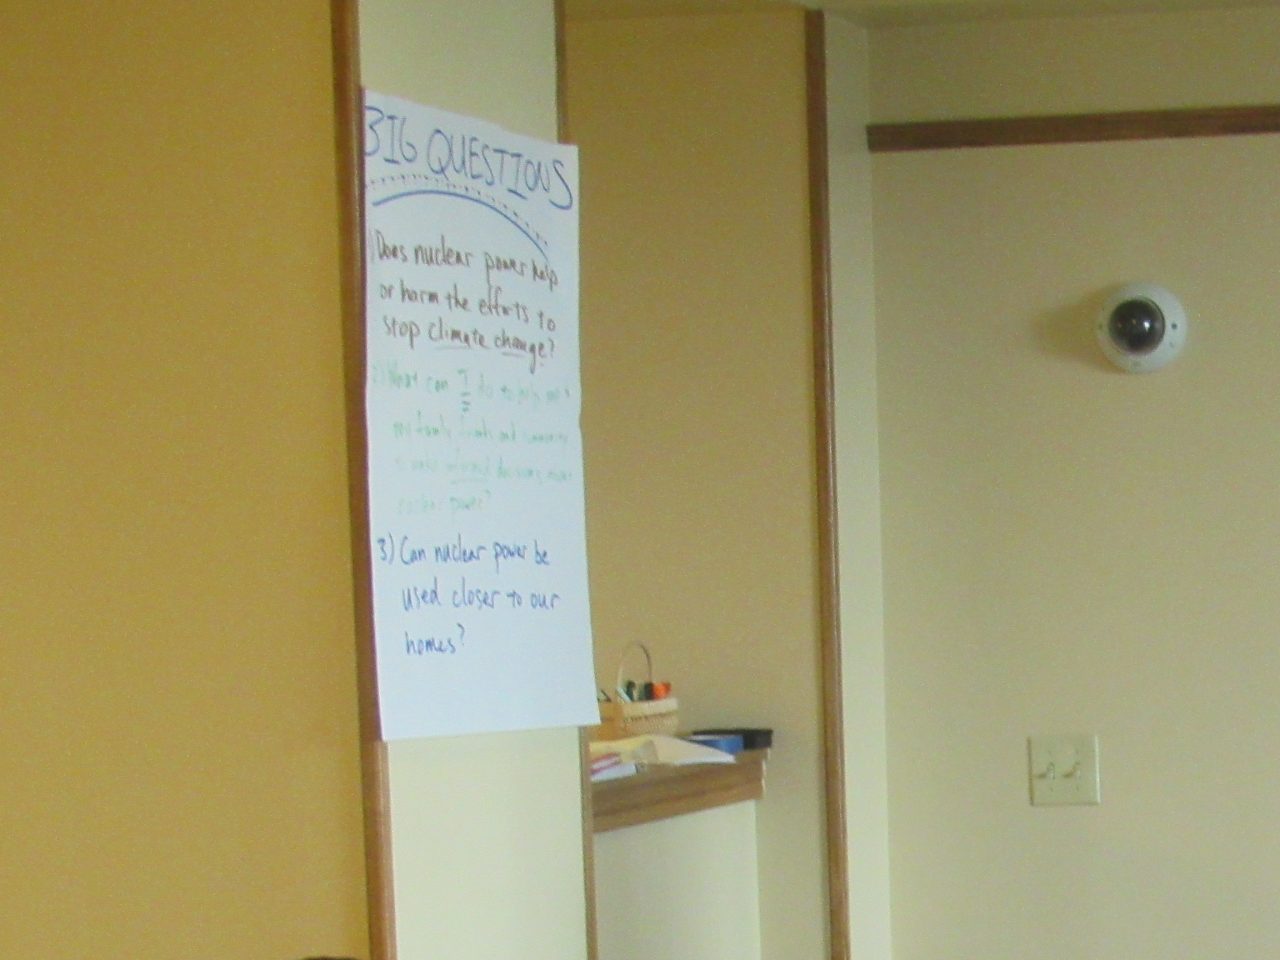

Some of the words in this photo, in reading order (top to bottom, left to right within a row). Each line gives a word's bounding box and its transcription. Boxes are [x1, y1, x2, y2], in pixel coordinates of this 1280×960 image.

[427, 129, 573, 210] QUESTIONS
[374, 228, 408, 263] Does
[414, 234, 474, 268] nuclear
[484, 251, 526, 287] power
[532, 258, 559, 292] help
[380, 284, 394, 300] or
[400, 279, 439, 305] harm
[446, 284, 470, 313] the
[479, 286, 529, 323] efforts
[537, 309, 556, 333] to
[429, 317, 488, 348] climate
[494, 329, 555, 374] change?
[400, 537, 427, 567] Can
[434, 534, 486, 566] nuclear
[494, 539, 527, 575] power
[534, 540, 550, 567] be
[403, 578, 439, 611] used
[453, 578, 500, 609] closer
[505, 591, 522, 608] to
[530, 590, 560, 611] our
[405, 623, 466, 657] homes?
